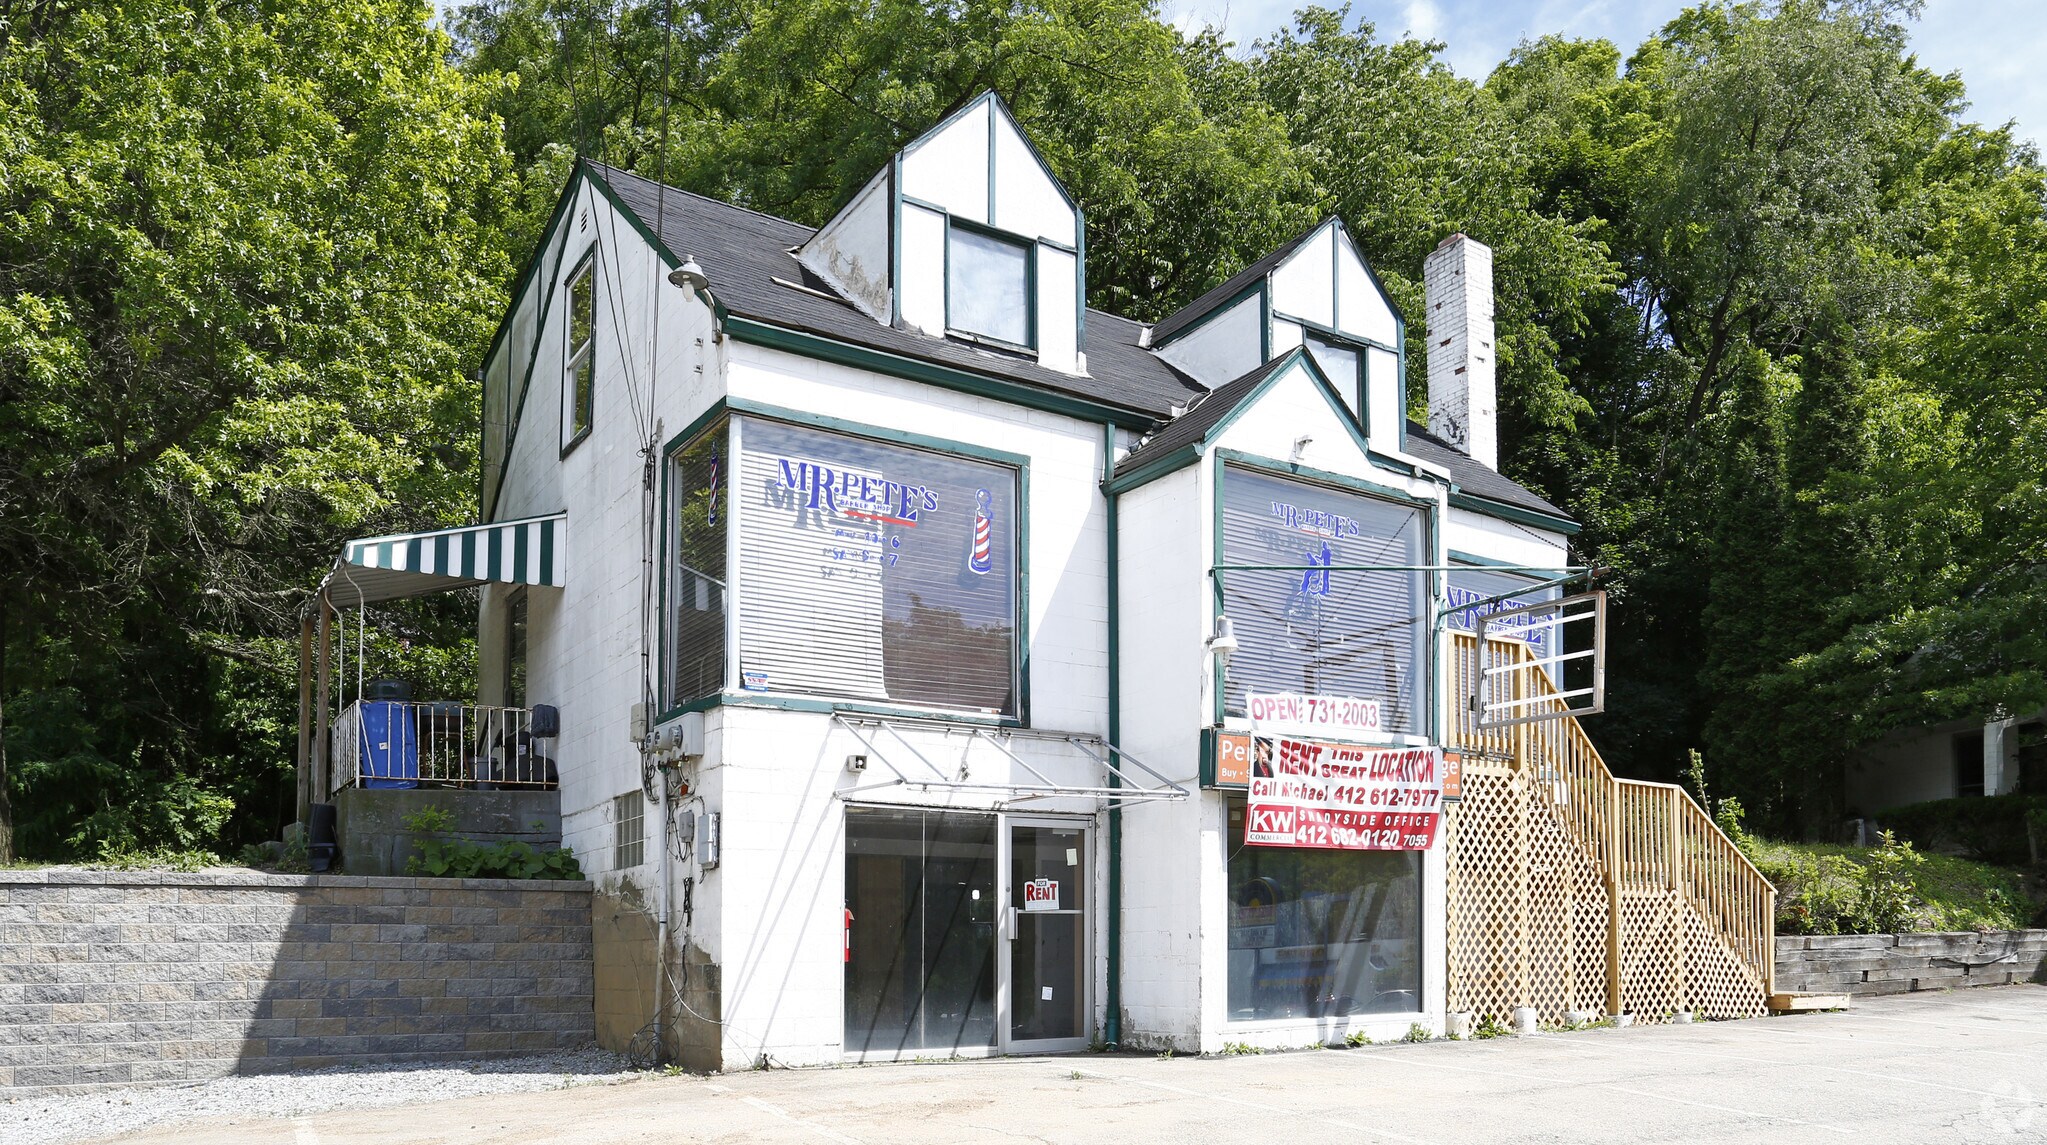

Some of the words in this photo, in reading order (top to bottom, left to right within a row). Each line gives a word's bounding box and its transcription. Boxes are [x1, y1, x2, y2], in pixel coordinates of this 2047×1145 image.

[873, 504, 891, 512] SHOP
[890, 535, 900, 549] 6
[888, 552, 899, 567] 7
[1251, 698, 1298, 721] OPEN
[1308, 699, 1378, 728] 731-2003
[1222, 740, 1250, 762] Pe
[1279, 740, 1322, 777] RENT
[1221, 767, 1237, 780] Buy
[1321, 764, 1367, 780] GREAT
[1369, 750, 1435, 783] LOCATION
[1253, 780, 1277, 797] Call
[1281, 782, 1329, 802] Michael
[1334, 786, 1366, 805] 412
[1370, 788, 1439, 807] 612-7977
[1252, 810, 1294, 833] KW
[1384, 815, 1431, 827] OFFICE
[1297, 825, 1327, 844] 412
[1331, 827, 1401, 847] 682-0120
[1403, 834, 1428, 847] 7055
[1026, 884, 1057, 901] RENT
